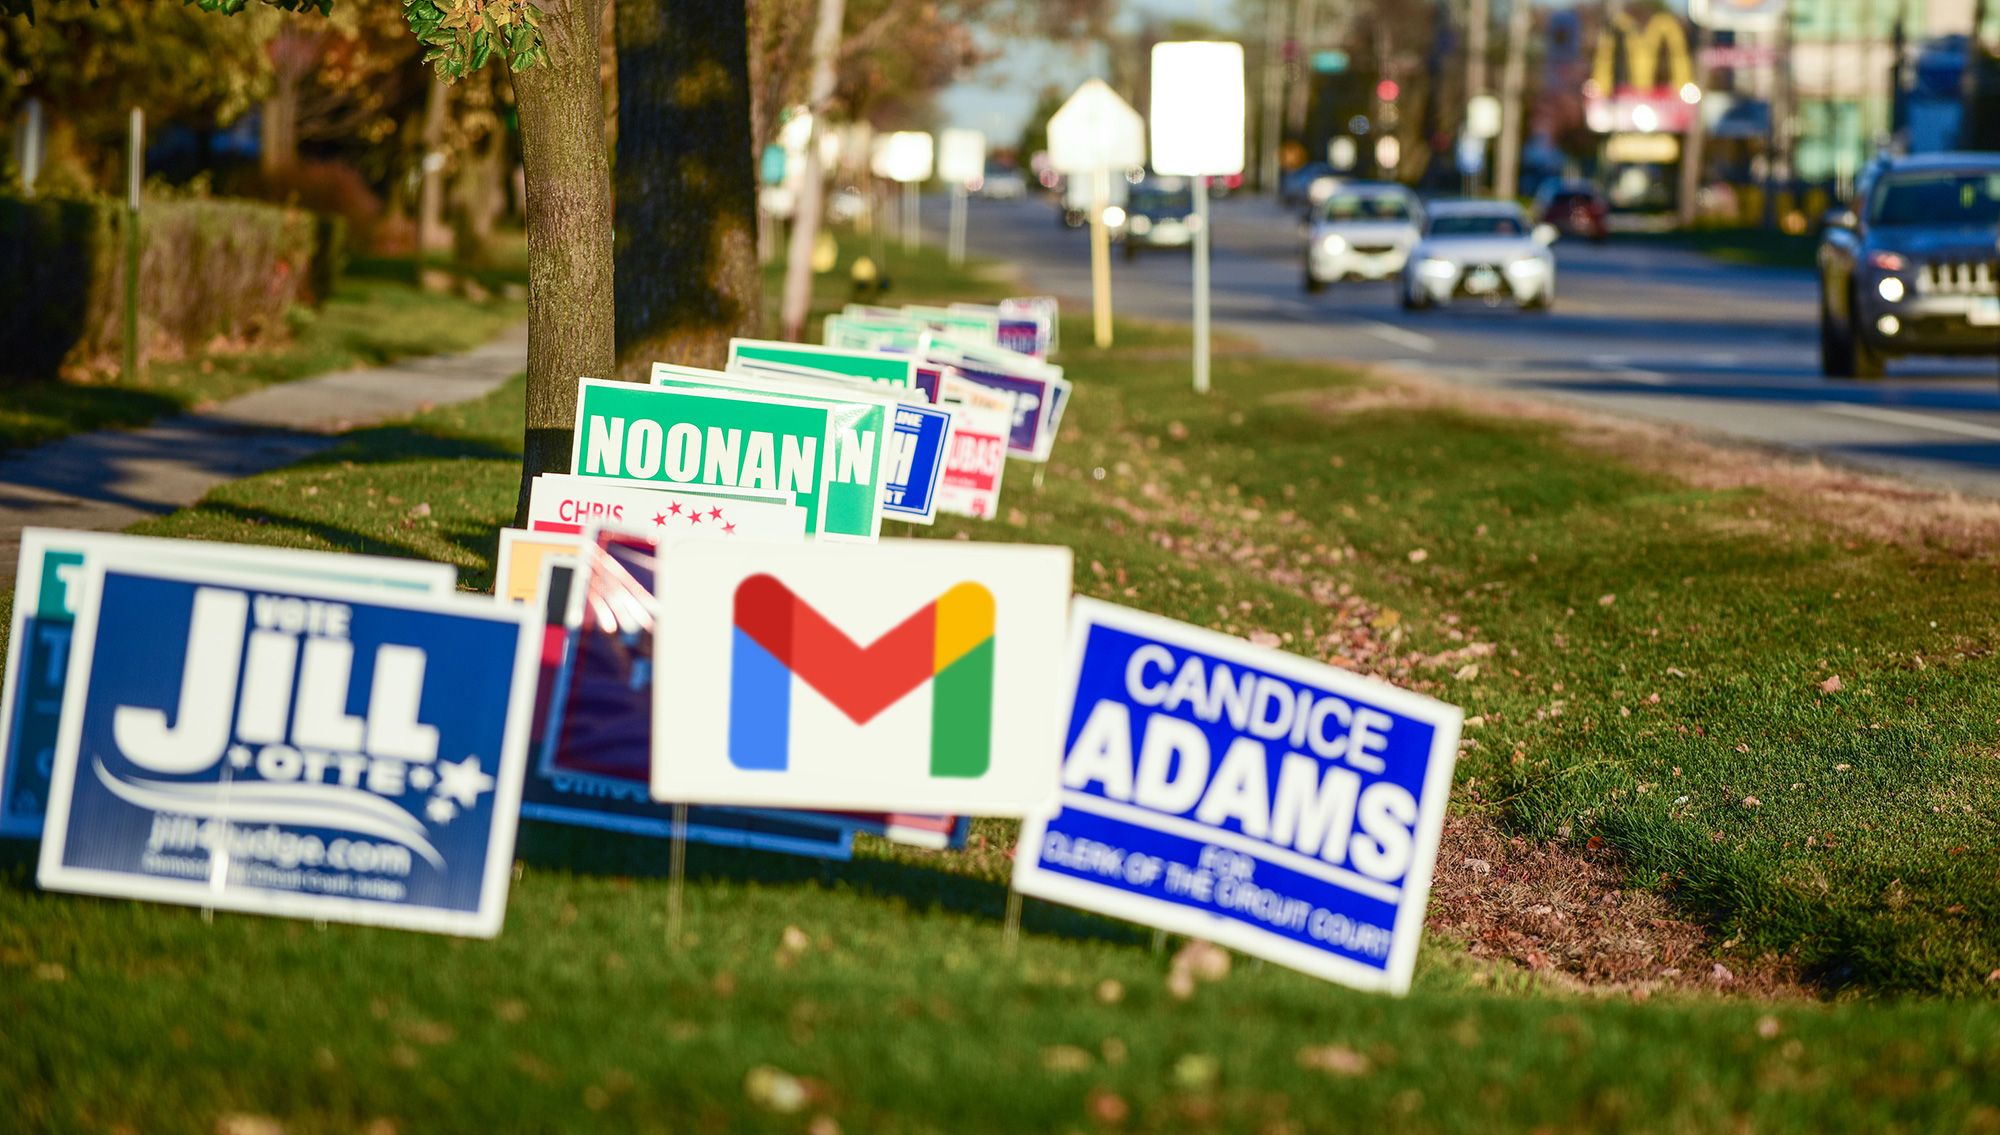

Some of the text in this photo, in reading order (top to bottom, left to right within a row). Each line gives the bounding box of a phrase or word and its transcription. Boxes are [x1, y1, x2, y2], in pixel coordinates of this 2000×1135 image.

[585, 414, 817, 494] NOONAN
[559, 499, 624, 523] CHRIS
[253, 594, 353, 638] VOTE
[113, 586, 440, 775] JILL
[1125, 644, 1393, 775] CANDICE
[256, 744, 406, 797] OTTE
[1063, 699, 1418, 883] ADAMS
[1041, 830, 1394, 961] CLERK OF THE CIRCUIT COURT
[1198, 845, 1257, 883] FOR
